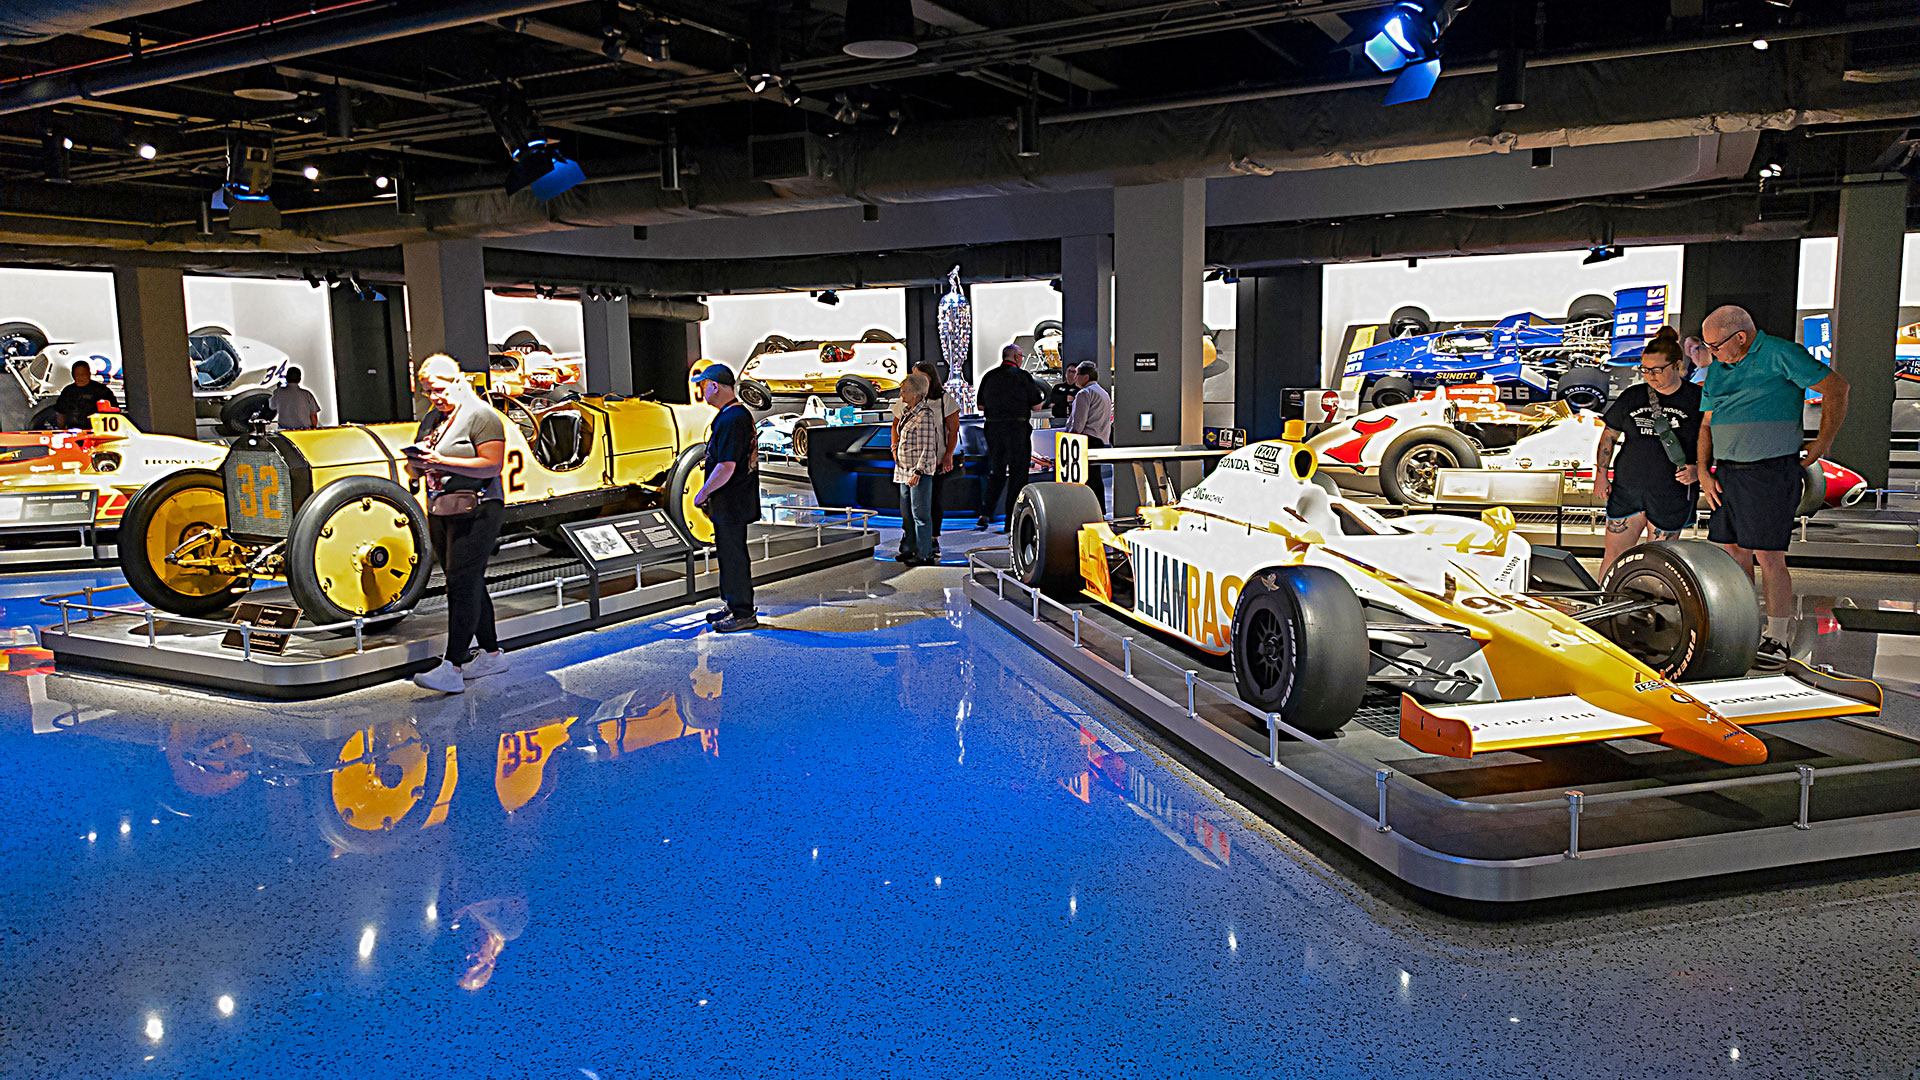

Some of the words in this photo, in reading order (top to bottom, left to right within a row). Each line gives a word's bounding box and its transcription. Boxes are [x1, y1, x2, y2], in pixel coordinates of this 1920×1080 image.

[882, 358, 898, 374] 9
[1435, 372, 1478, 380] SUNOCO
[1500, 386, 1530, 400] 66
[1564, 386, 1605, 403] GOODYEAR
[1663, 407, 1689, 419] NOODLE
[101, 417, 119, 432] 10
[1640, 427, 1653, 436] LIVE
[1060, 436, 1080, 482] 98
[1254, 445, 1281, 461] IZOD
[507, 450, 525, 492] 2
[236, 463, 281, 519] 32
[1617, 553, 1645, 569] 500
